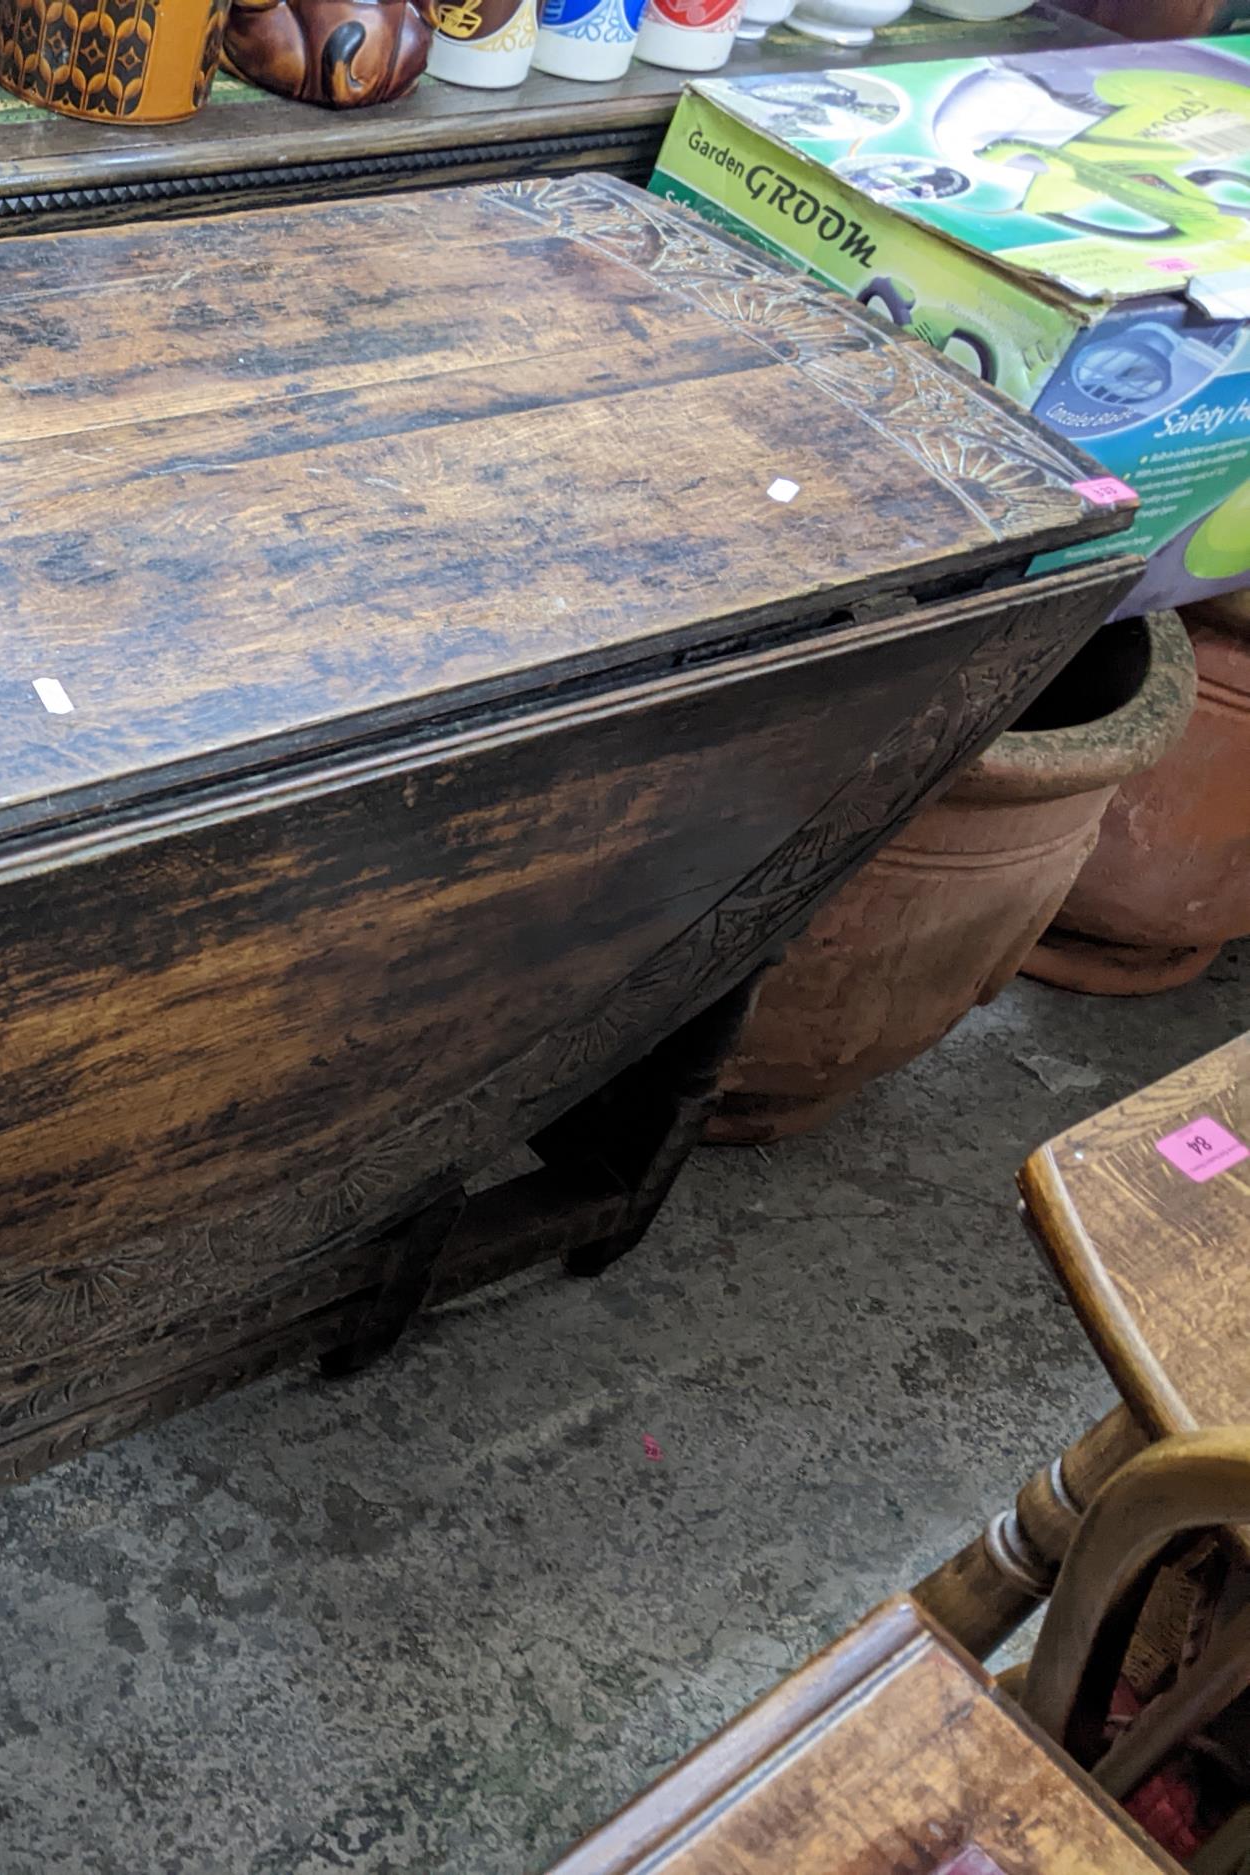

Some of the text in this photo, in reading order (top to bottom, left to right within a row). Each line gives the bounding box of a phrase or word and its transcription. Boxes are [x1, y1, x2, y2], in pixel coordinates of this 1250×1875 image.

[688, 131, 745, 178] Garden
[1153, 404, 1230, 438] Safety
[1186, 1135, 1213, 1155] 84
